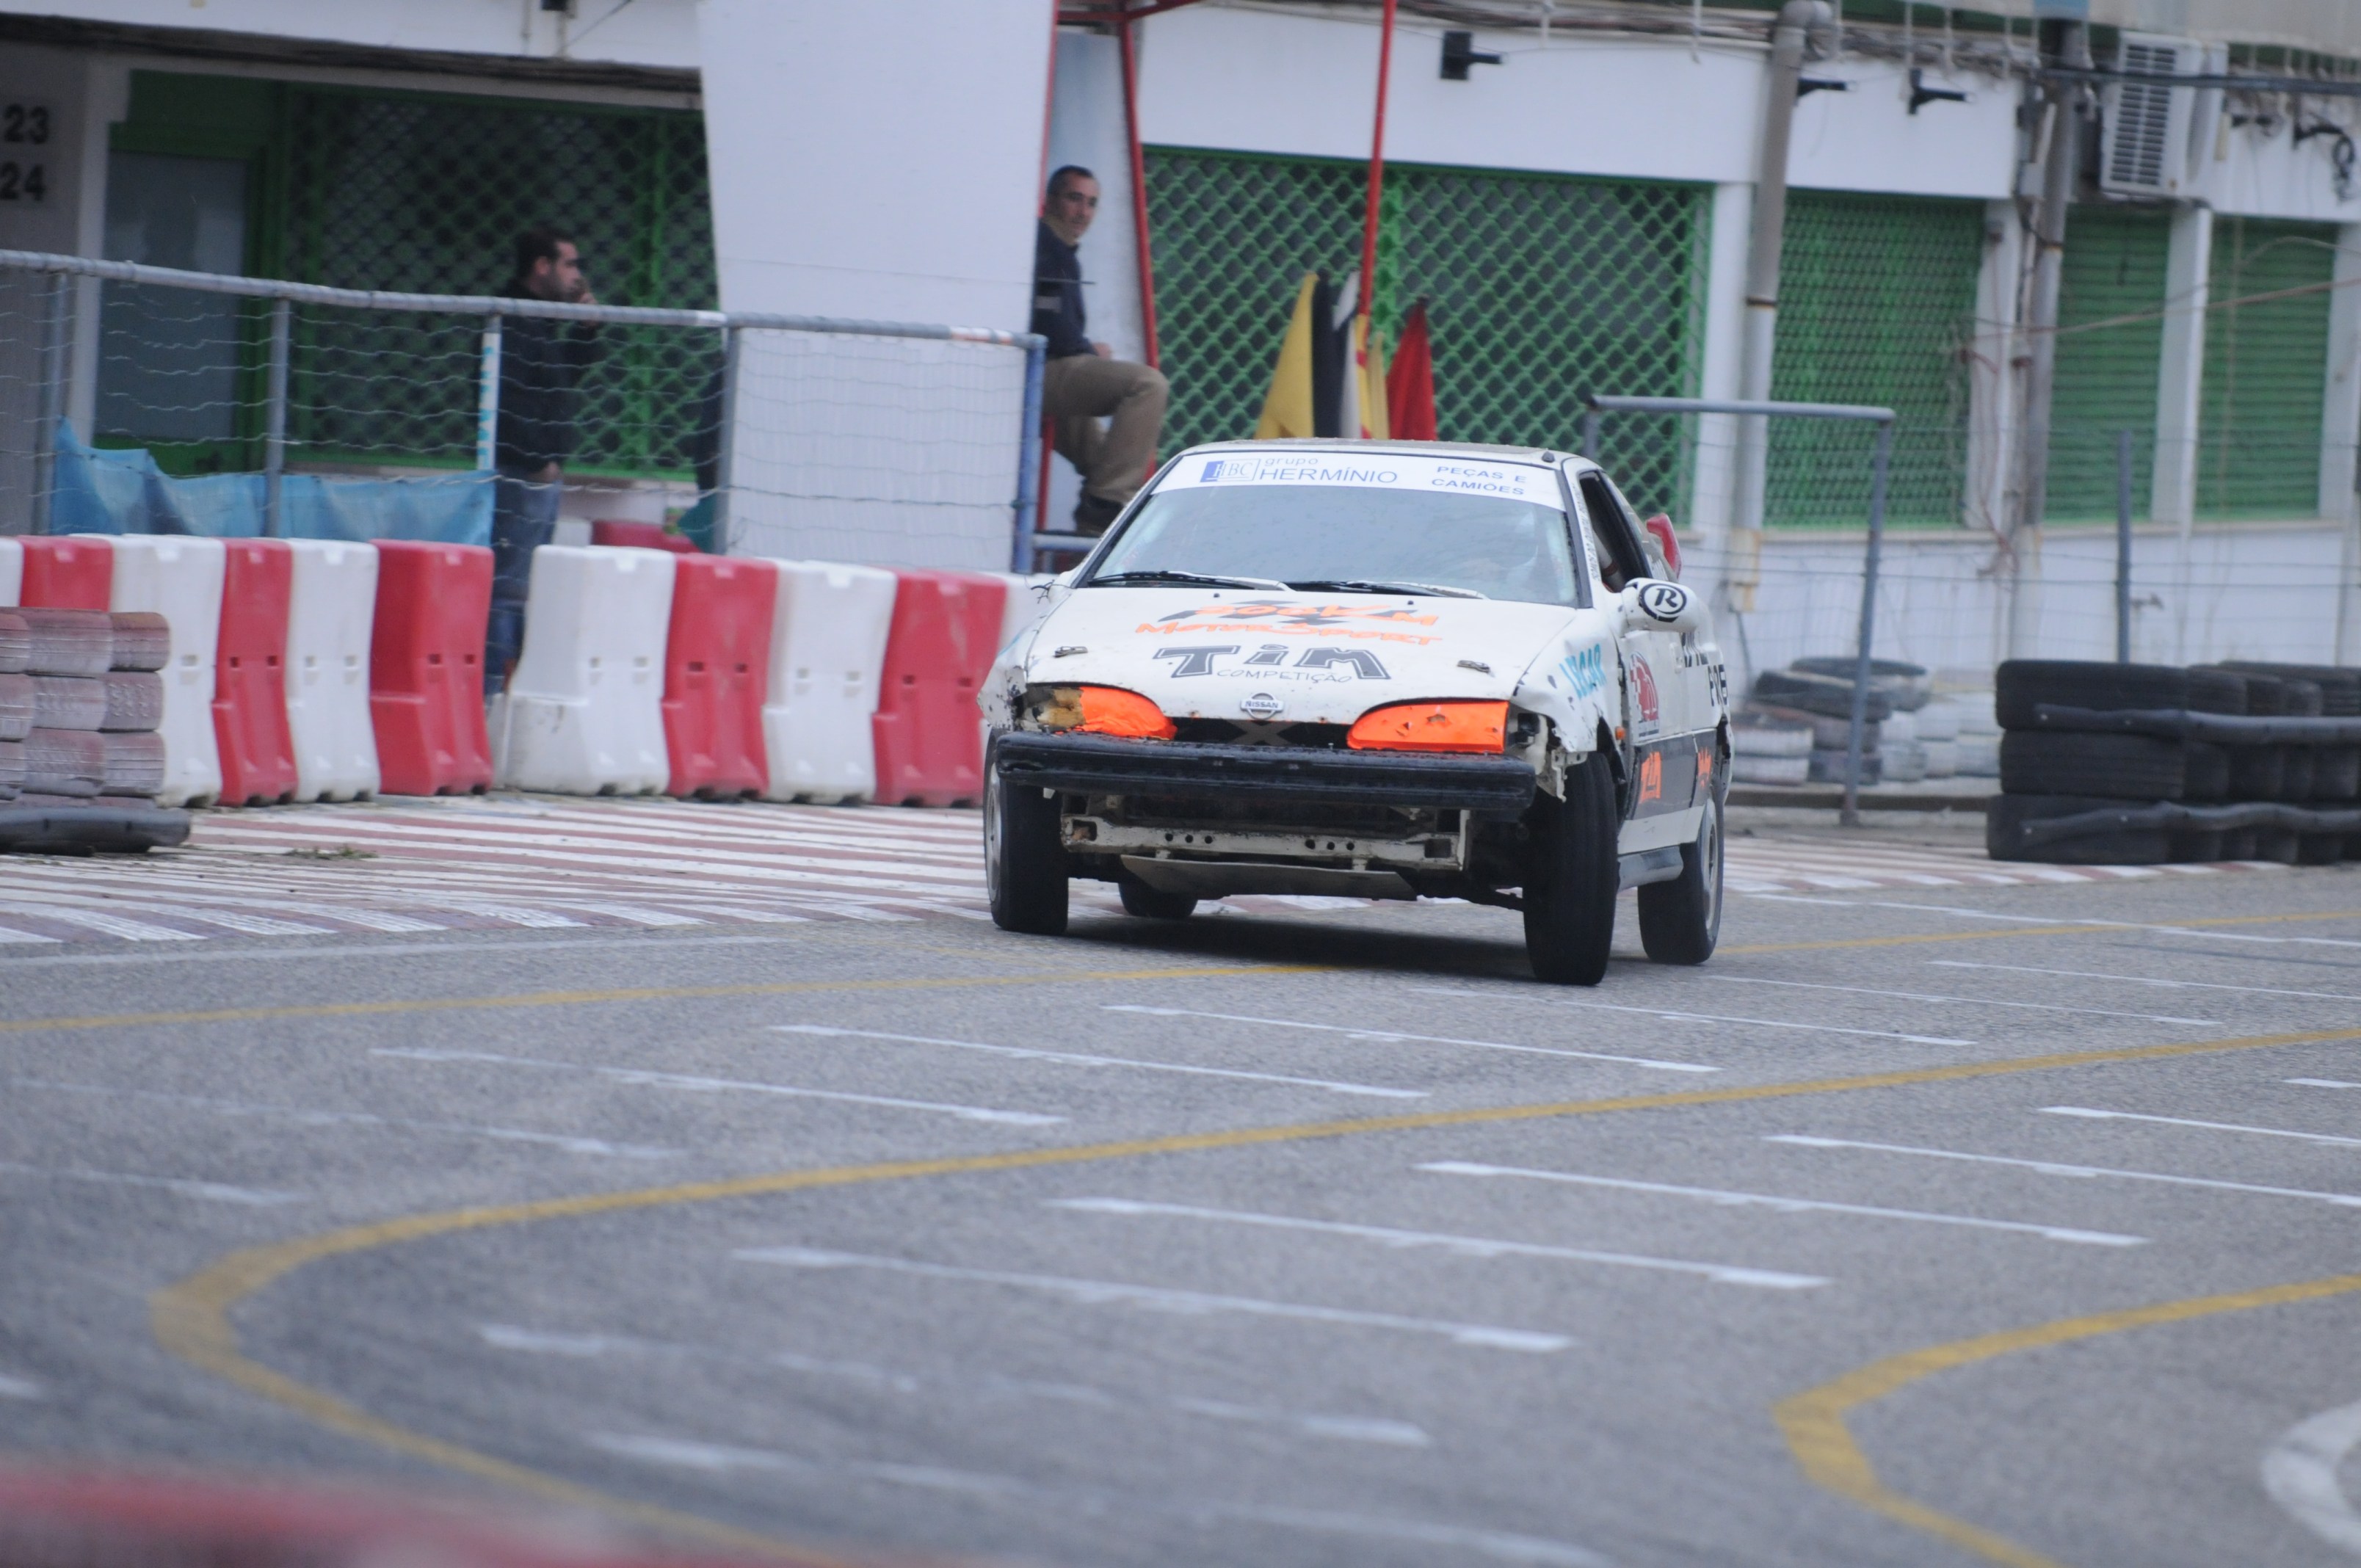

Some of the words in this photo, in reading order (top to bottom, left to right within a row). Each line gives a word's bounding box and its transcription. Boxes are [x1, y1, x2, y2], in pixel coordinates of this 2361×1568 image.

[4, 104, 49, 144] 23
[0, 161, 45, 200] 24
[1264, 457, 1319, 467] grupo
[1259, 467, 1398, 483] HERMÍNIO
[1437, 465, 1504, 479] PEÇAS
[1431, 479, 1525, 496] CAMIÕES
[1216, 669, 1352, 683] COMPETIÇÃO
[1244, 700, 1279, 709] NISSAN
